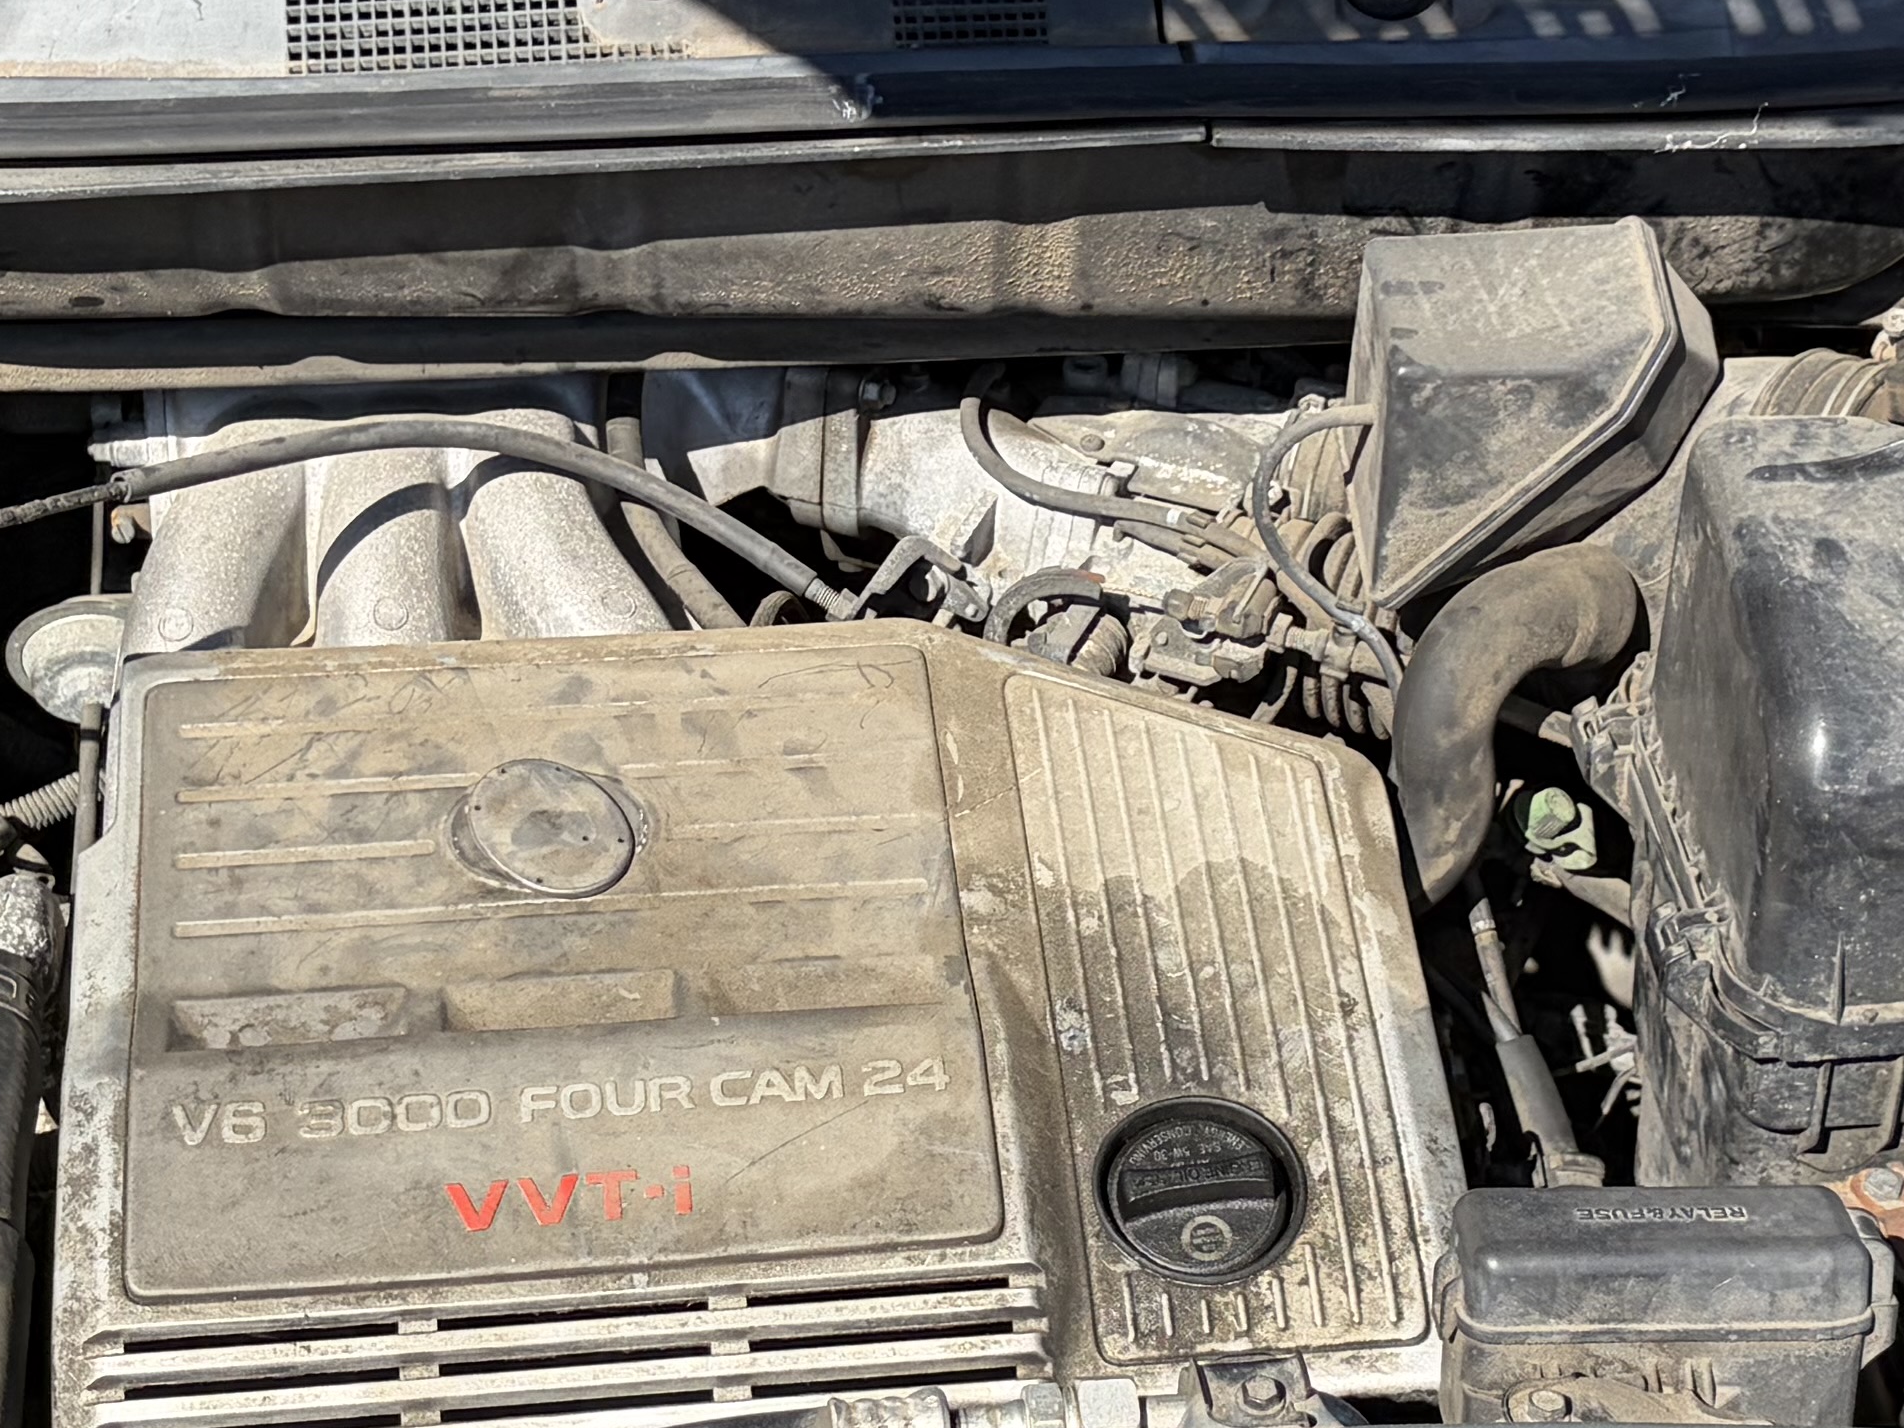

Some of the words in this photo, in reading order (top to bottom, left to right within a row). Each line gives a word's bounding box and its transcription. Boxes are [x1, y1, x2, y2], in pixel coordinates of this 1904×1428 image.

[172, 1100, 267, 1147] V6
[295, 1090, 491, 1140] 3000
[518, 1074, 694, 1125] FOUR
[711, 1065, 843, 1110] CAM
[863, 1057, 952, 1099] 24
[1128, 1124, 1192, 1165] CONSERVING
[1153, 1144, 1190, 1162] 5W-30
[1196, 1142, 1221, 1155] SAE
[1203, 1125, 1246, 1151] ENERGY
[445, 1166, 694, 1233] VVT-i
